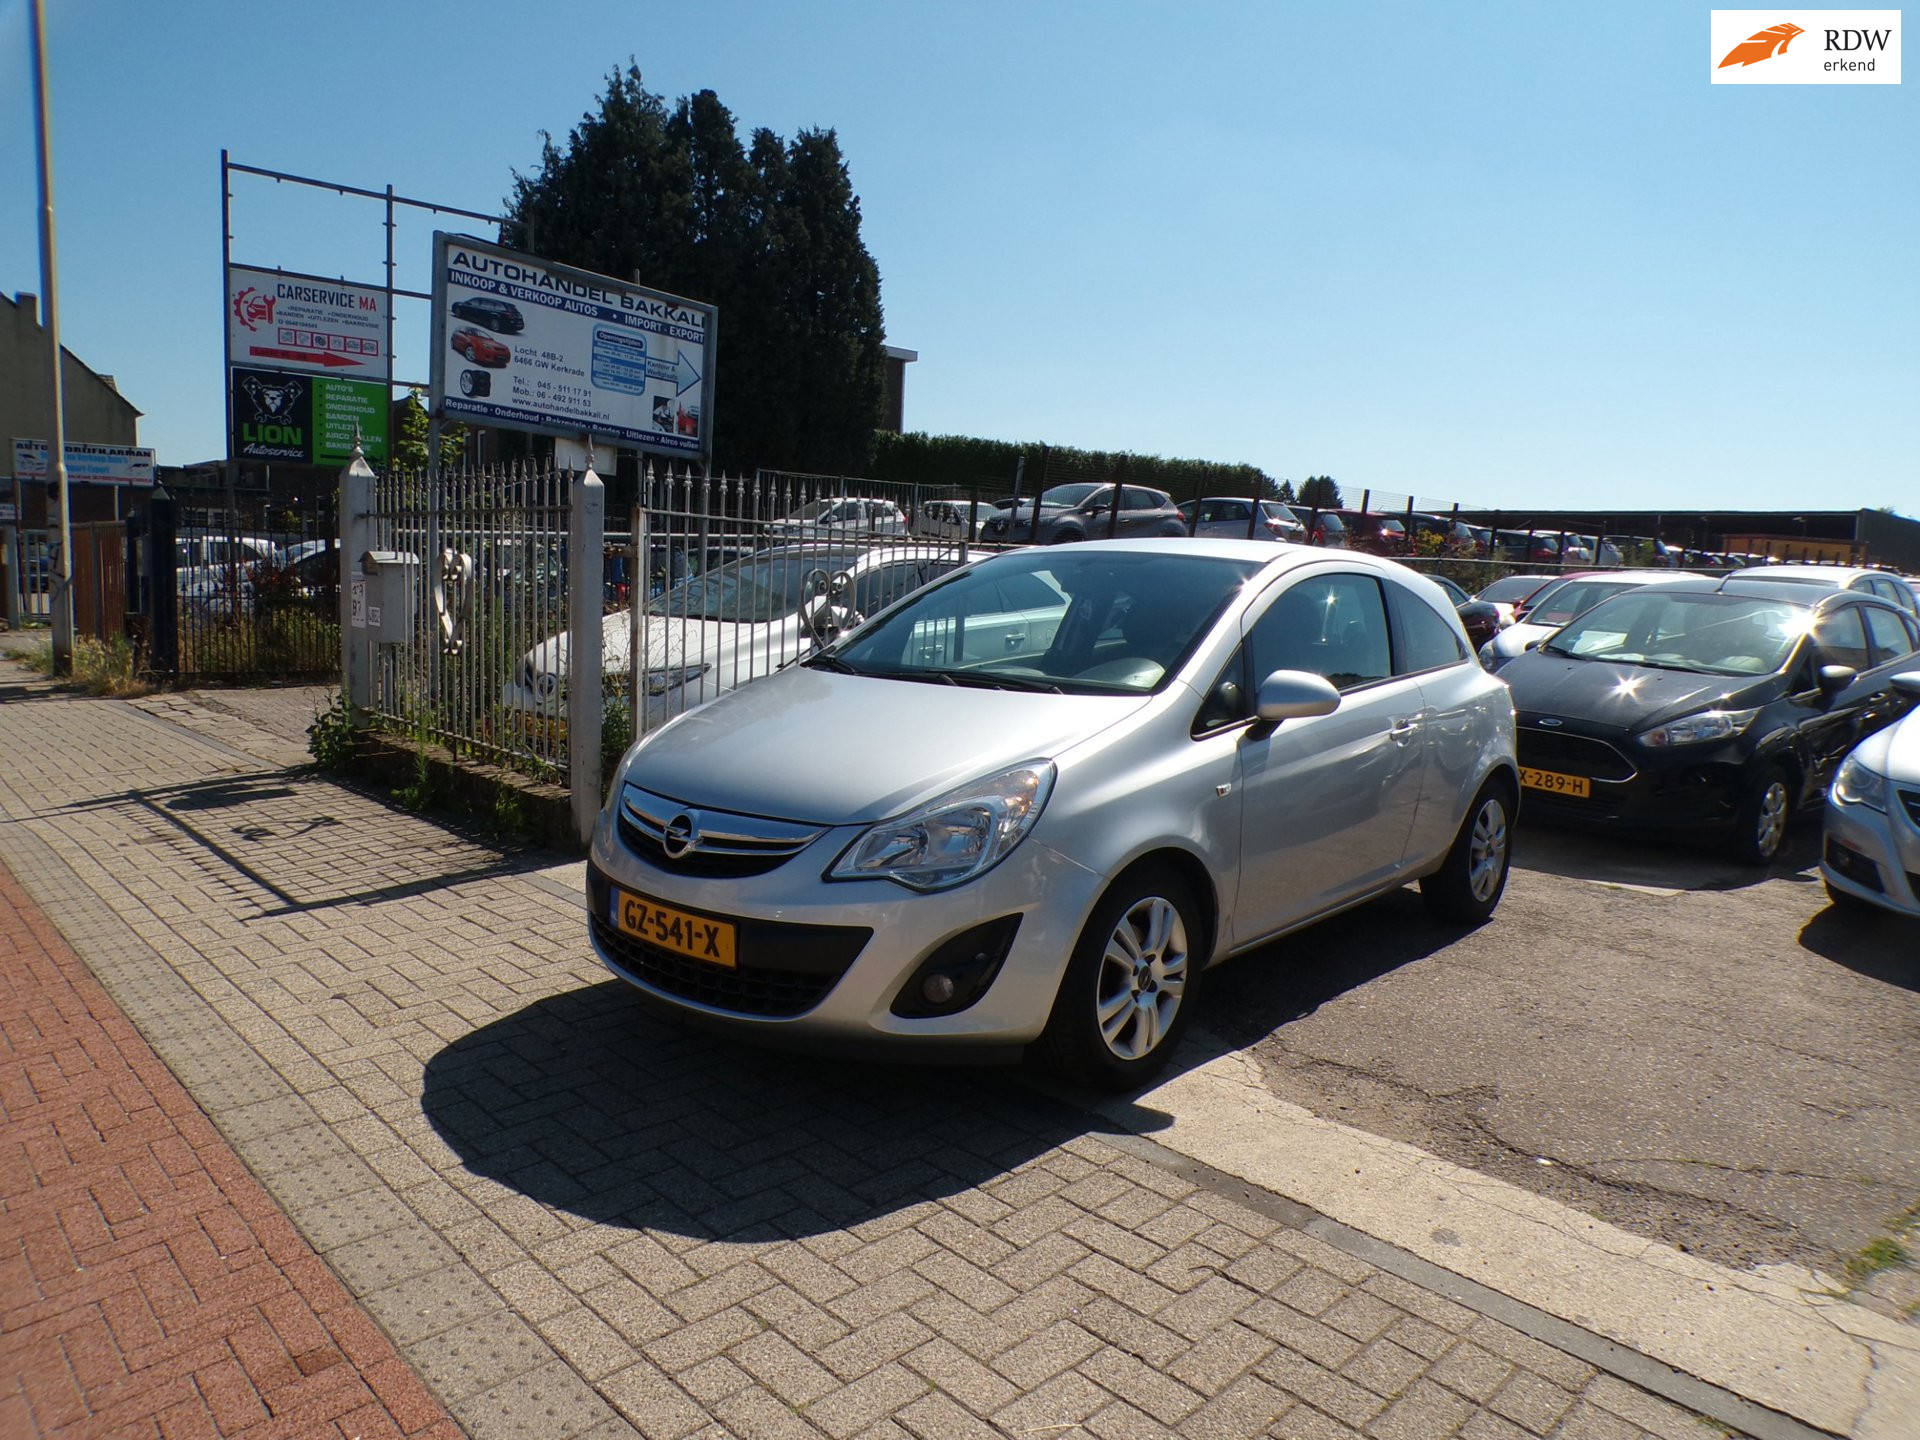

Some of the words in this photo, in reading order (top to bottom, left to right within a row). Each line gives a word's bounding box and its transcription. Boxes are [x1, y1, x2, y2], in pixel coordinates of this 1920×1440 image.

[277, 283, 355, 308] CARSERVICE
[359, 295, 377, 312] MA
[453, 252, 612, 305] AUTOHANDEL
[620, 296, 705, 328] BAKKALI
[451, 271, 496, 290] INKOOP
[498, 282, 508, 295] &
[510, 285, 562, 308] VERKOOP
[564, 301, 598, 316] AUTOS
[625, 314, 662, 332] IMPORT
[669, 326, 704, 342] EXPORT
[310, 314, 339, 324] UITLEZEN
[331, 311, 369, 321] ONDERHOUD
[599, 331, 641, 348] Openingstijden
[515, 345, 538, 357] Locht
[541, 351, 564, 363] 48B-2
[514, 356, 533, 366] 6466
[535, 360, 549, 369] GW
[551, 363, 585, 377] Kerkrade
[647, 360, 670, 371] Kantoor
[647, 368, 678, 380] Werkplaats
[325, 384, 353, 393] AUTO'S
[537, 381, 551, 390] 045
[558, 385, 571, 394] 511
[573, 388, 581, 396] 17
[583, 390, 591, 398] 91
[325, 393, 368, 404] REPARATIE
[536, 391, 546, 399] 06
[553, 394, 566, 403] 492
[583, 399, 591, 408] 53
[325, 403, 375, 414] ONDERHOUD
[512, 398, 610, 420] www.autohandelbakkali.nl
[325, 413, 359, 422] BANDEN
[445, 398, 488, 413] Reparatie
[495, 407, 540, 422] Onderhoud
[626, 429, 655, 442] Uitlezen
[661, 437, 678, 446] Airco
[242, 422, 302, 445] LION
[325, 423, 363, 432] UITLEZN
[325, 432, 350, 440] AIRCO
[243, 443, 304, 458] Autoservice
[624, 900, 720, 958] GZ-541-X
